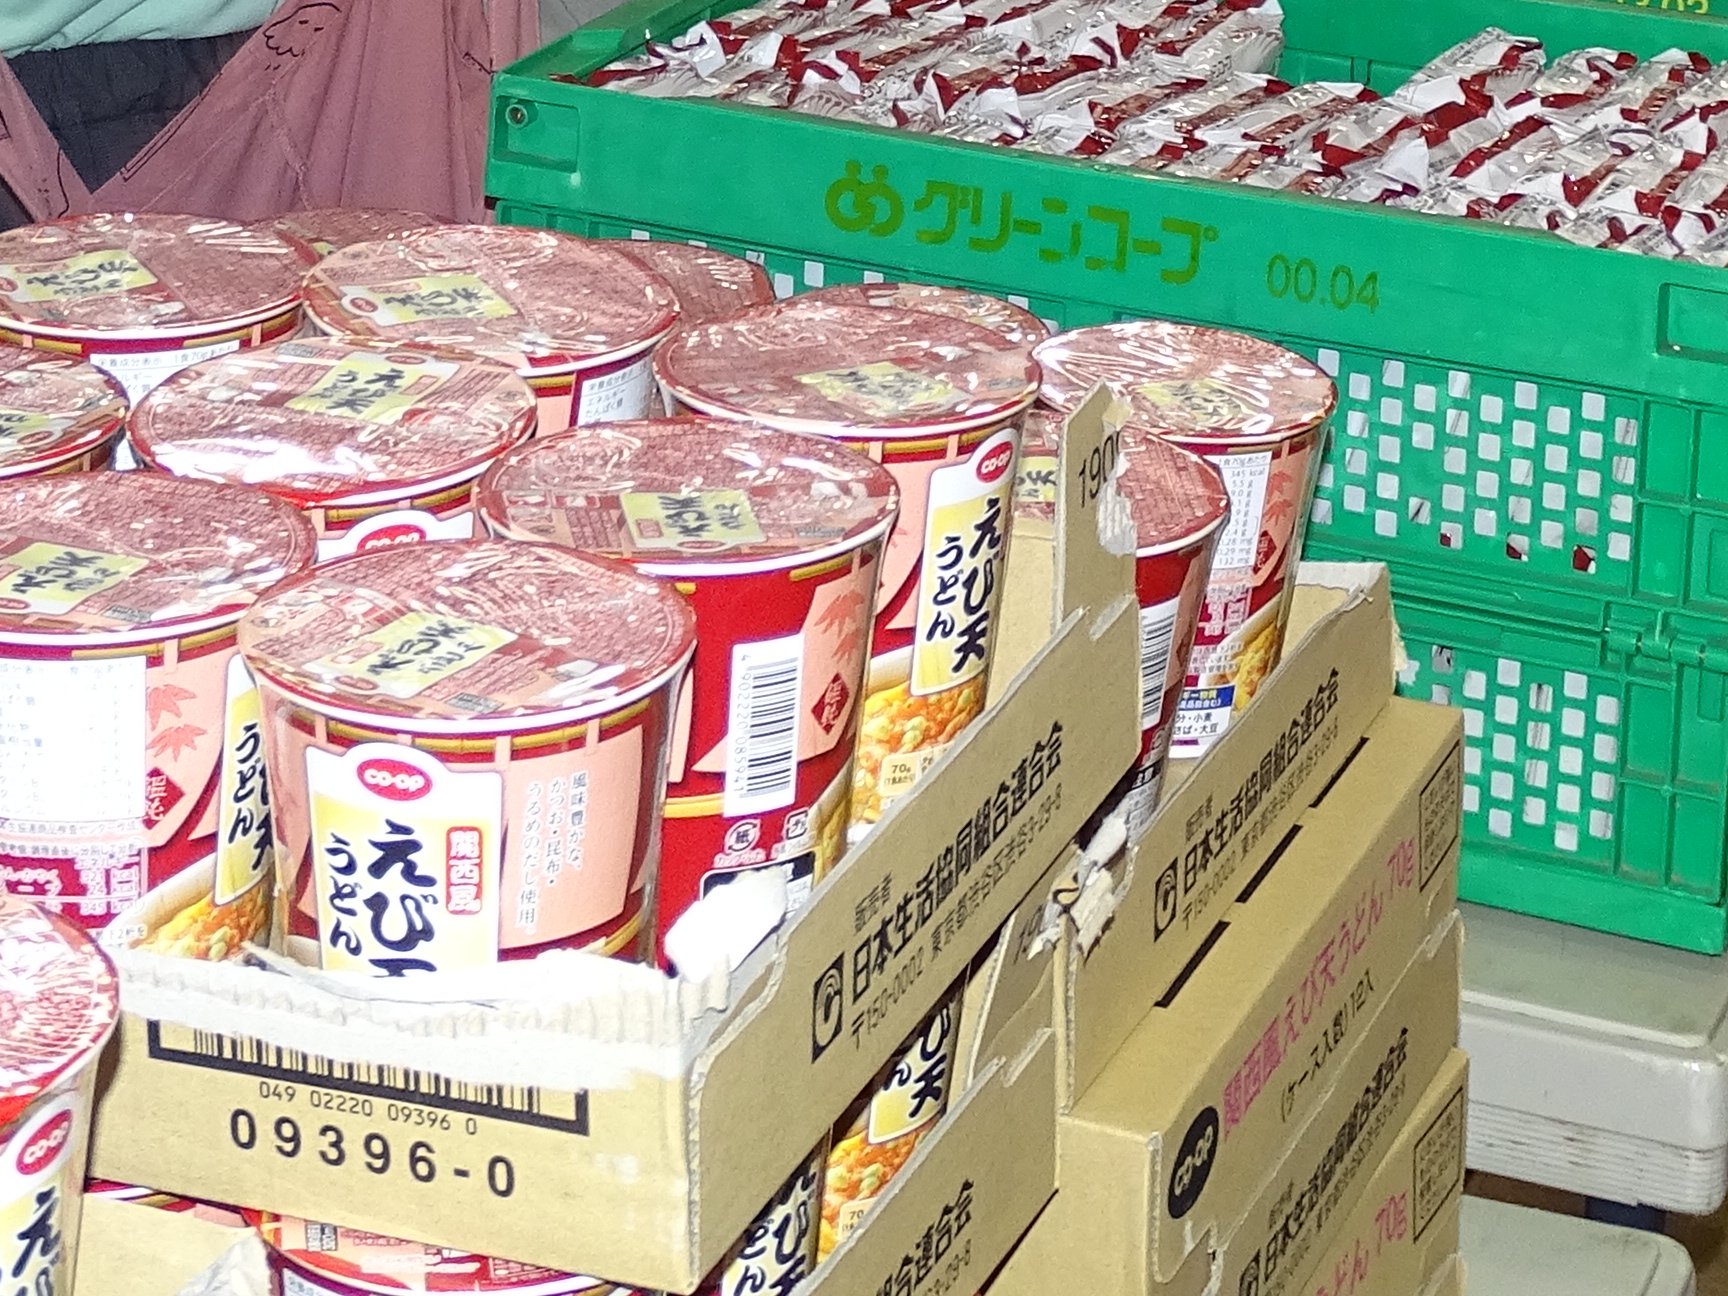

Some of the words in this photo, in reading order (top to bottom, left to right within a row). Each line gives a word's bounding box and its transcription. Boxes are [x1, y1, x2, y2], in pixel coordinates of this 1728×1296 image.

[913, 178, 1220, 285] グリーンコープ
[1266, 253, 1380, 313] 00.04
[925, 534, 964, 643] うどん
[952, 496, 1004, 674] えび天
[227, 723, 262, 844] うどん
[323, 832, 364, 957] うどん
[852, 720, 1063, 1005] 日本生活協同組合連合会
[230, 1107, 516, 1199] 09396-0
[258, 1080, 297, 1104] 049
[308, 1088, 373, 1118] 02220
[386, 1102, 451, 1132] 09396
[464, 1116, 478, 1136] 0
